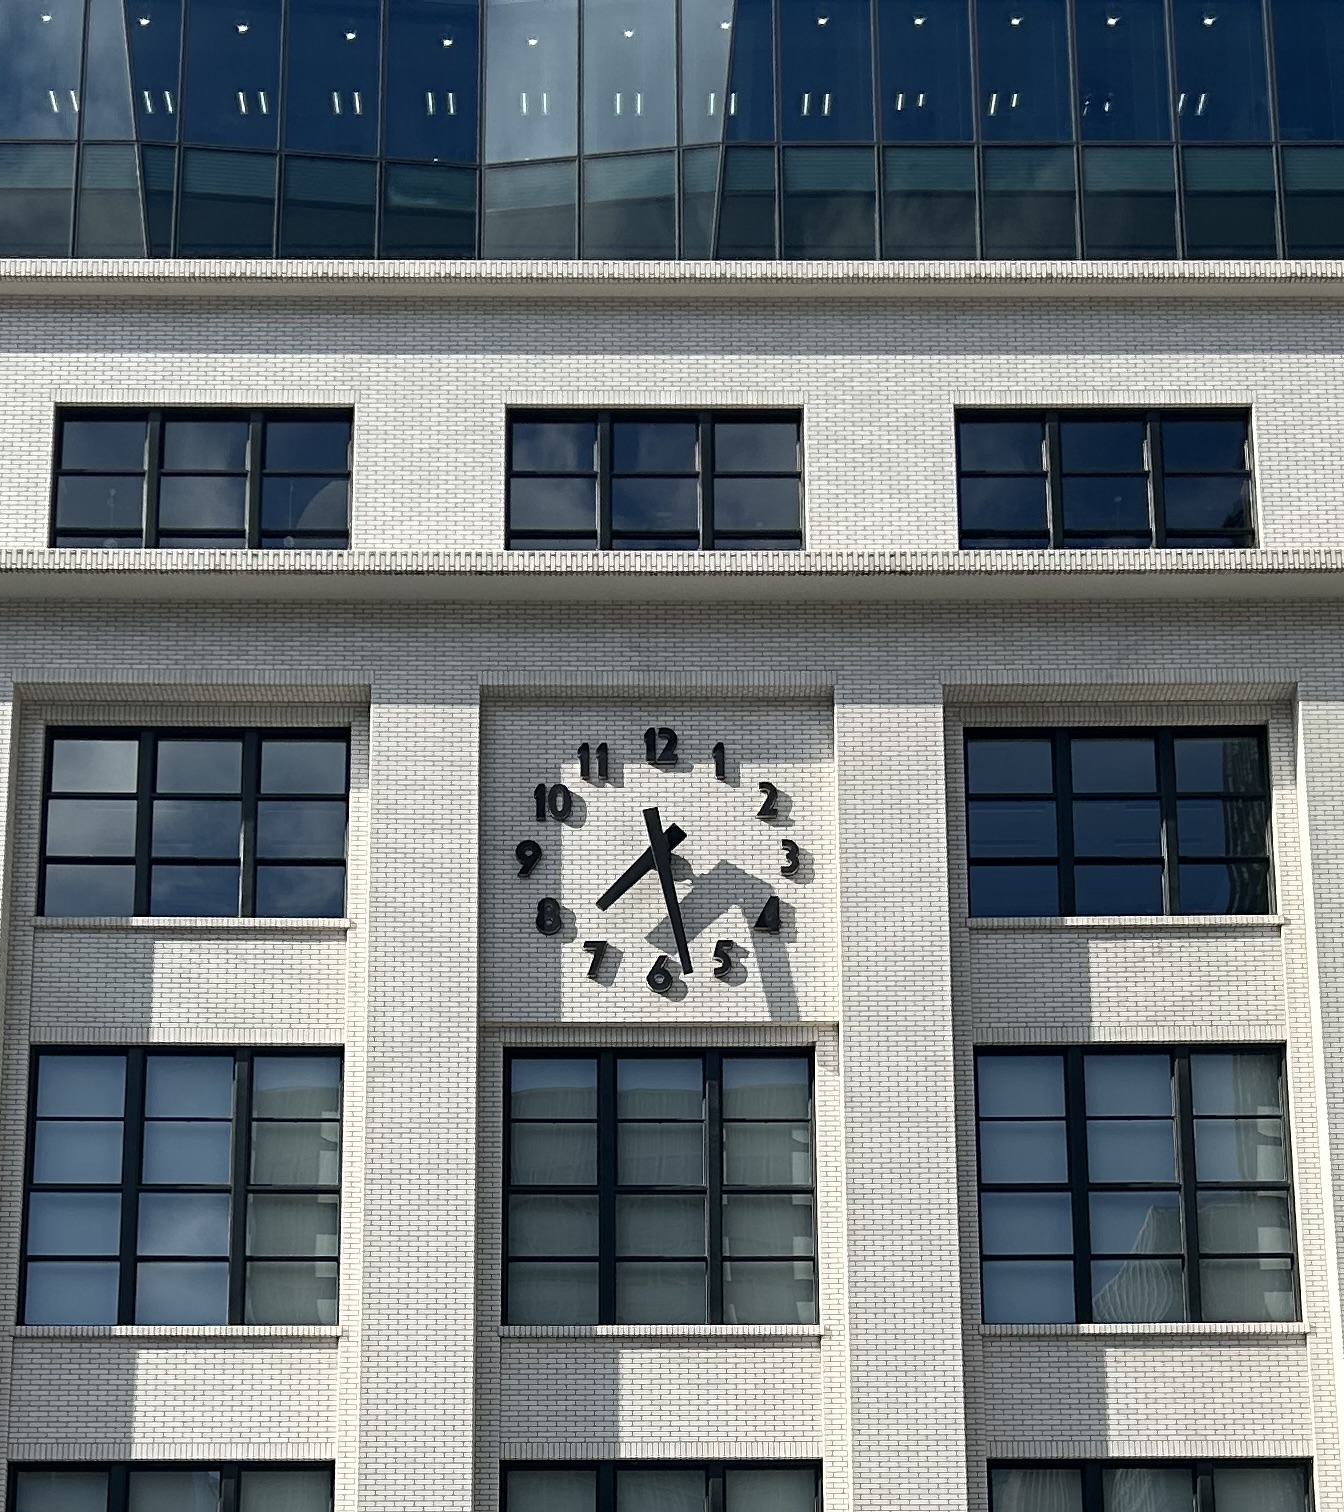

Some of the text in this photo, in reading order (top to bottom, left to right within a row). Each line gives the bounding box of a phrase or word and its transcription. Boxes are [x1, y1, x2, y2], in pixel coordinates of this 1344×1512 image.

[577, 742, 610, 779] 11
[644, 727, 679, 764] 12
[712, 742, 726, 779] 1
[534, 783, 573, 822] 10
[756, 782, 779, 819] 2
[515, 840, 543, 878] 9
[781, 839, 801, 876] 3
[536, 897, 563, 935] 8
[754, 895, 781, 934] 4
[583, 940, 609, 979] 7
[646, 954, 674, 994] 6
[713, 939, 735, 978] 5
